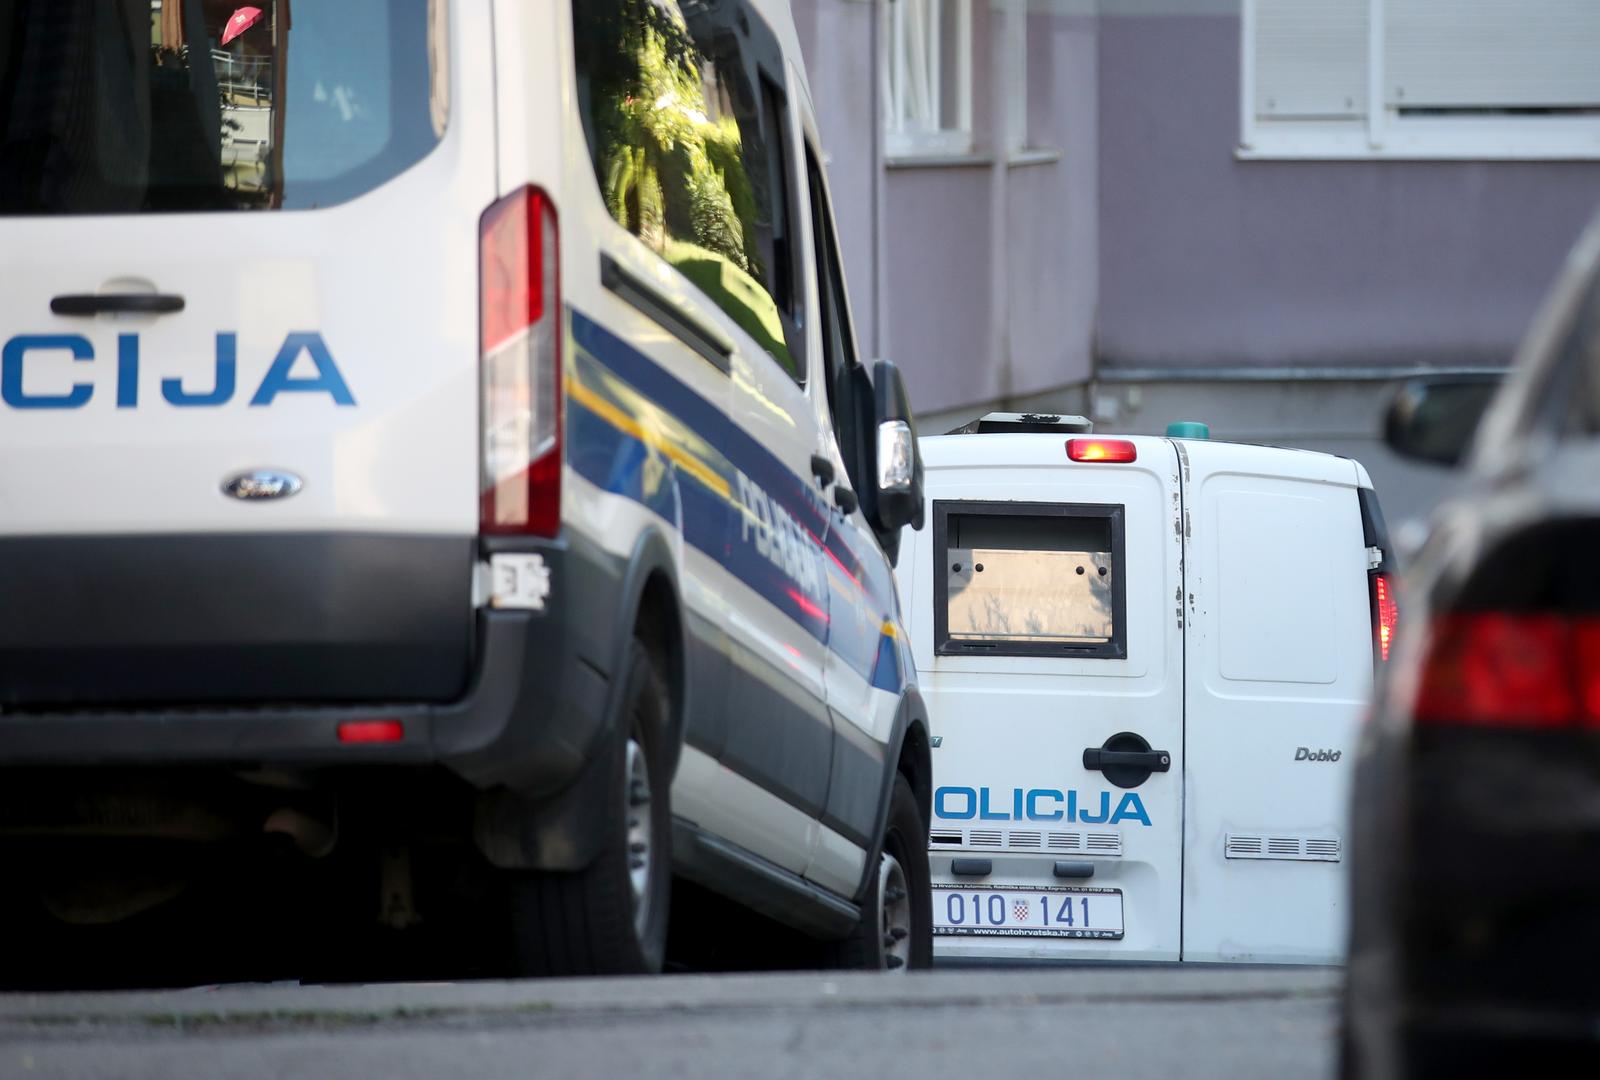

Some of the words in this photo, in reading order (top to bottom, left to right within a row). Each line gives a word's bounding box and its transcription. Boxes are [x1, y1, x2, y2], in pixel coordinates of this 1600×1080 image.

[1, 331, 357, 409] CIJA
[947, 893, 1006, 925] 010
[1040, 896, 1090, 927] 141
[973, 927, 1070, 937] www.autohrvatska.hr
